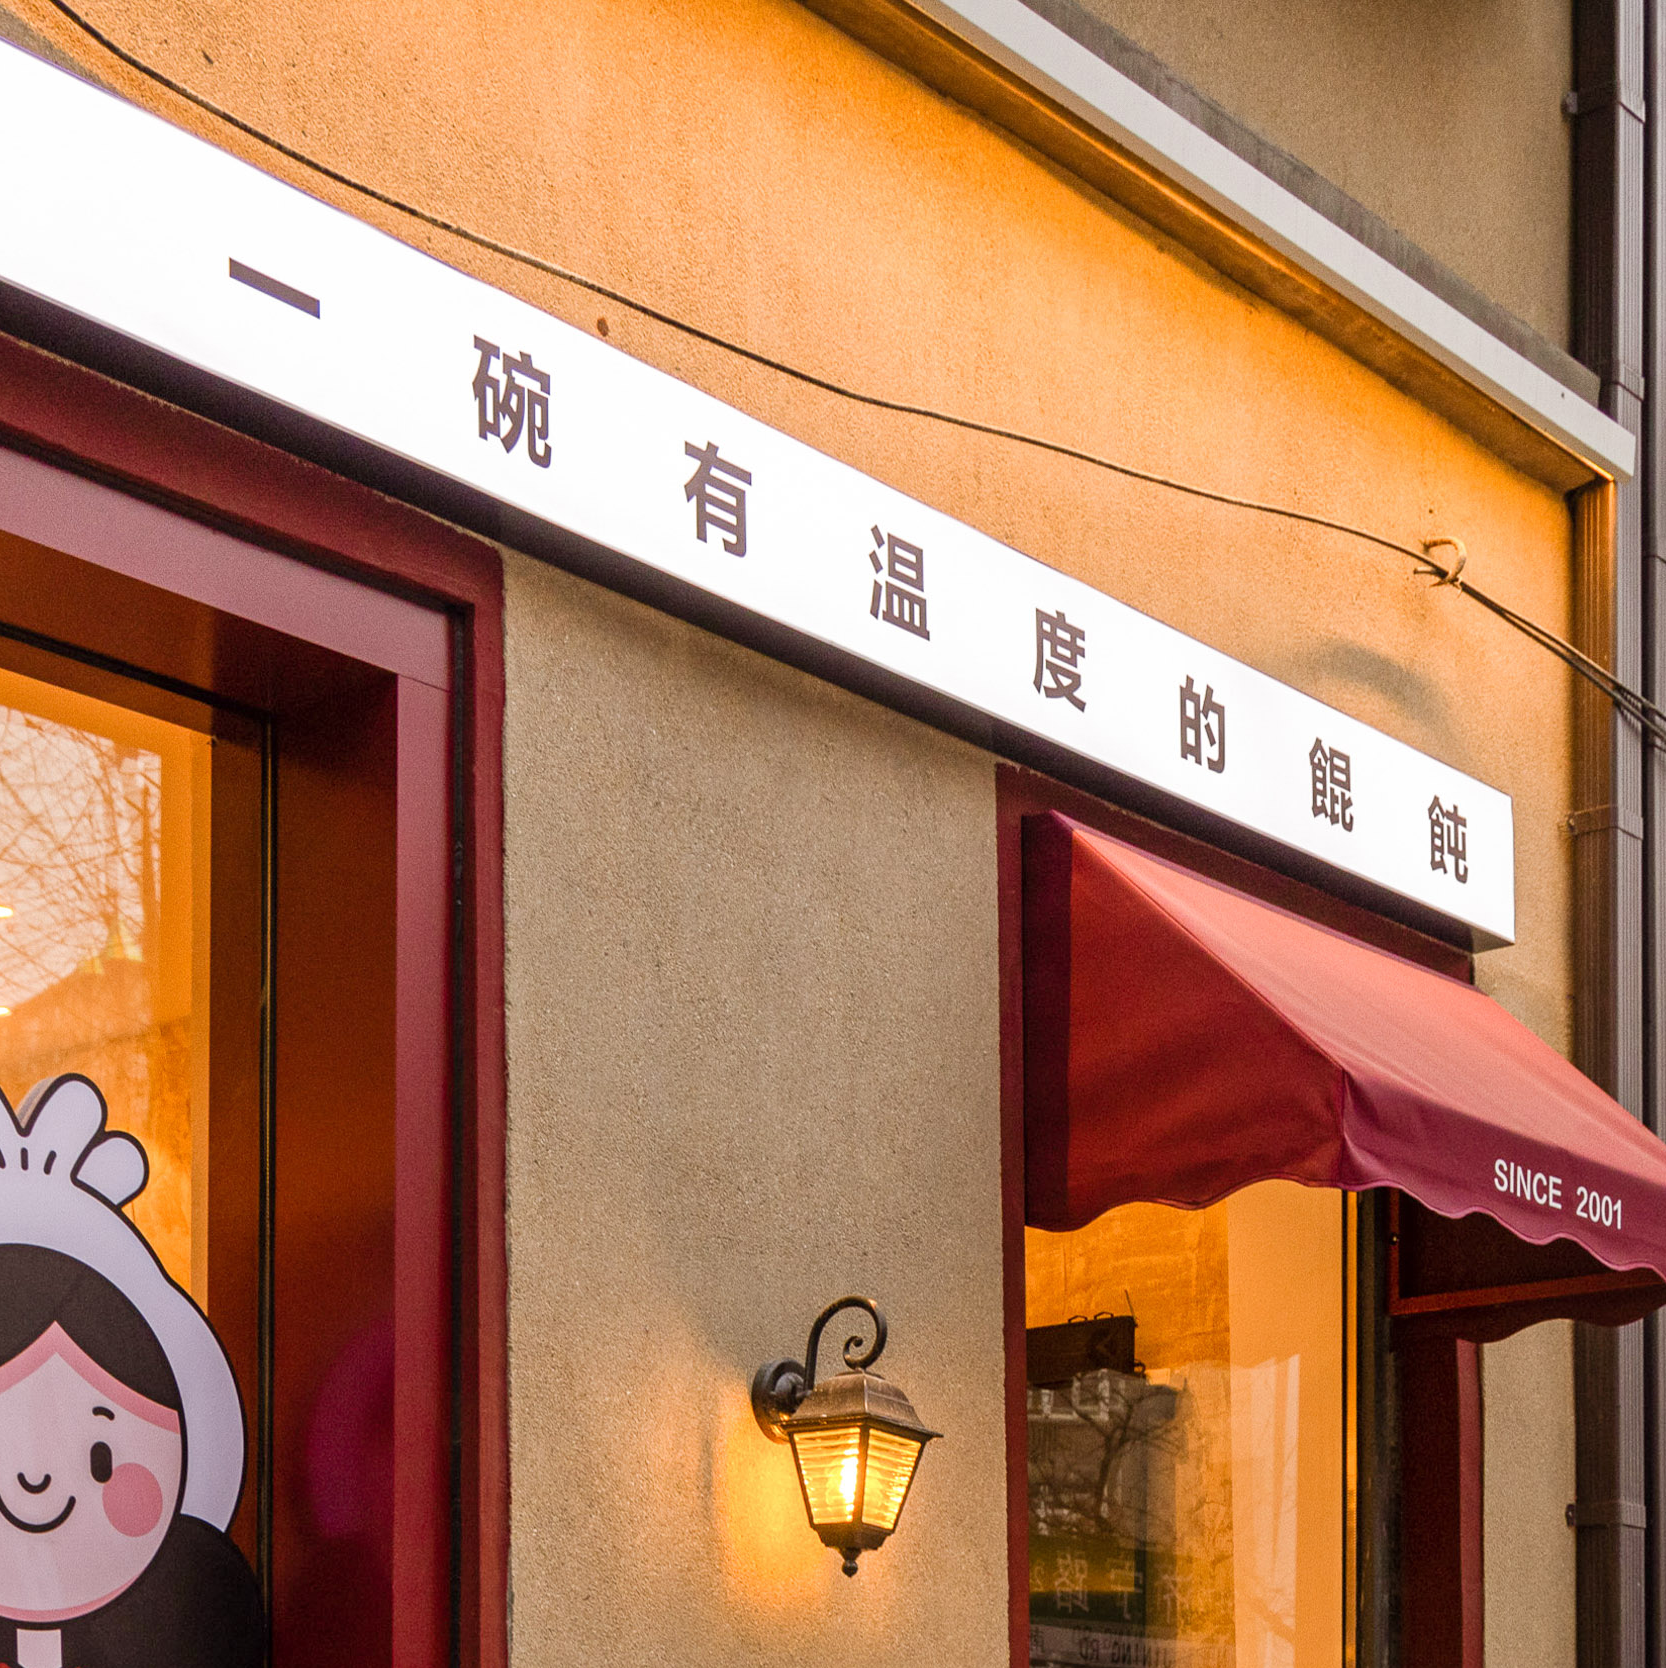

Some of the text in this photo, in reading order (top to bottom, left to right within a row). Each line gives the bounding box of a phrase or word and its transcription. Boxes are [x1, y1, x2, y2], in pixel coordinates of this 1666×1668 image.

[228, 257, 1470, 884] 一碗有温度的餛飩
[1493, 1158, 1623, 1230] SINCE 2001
